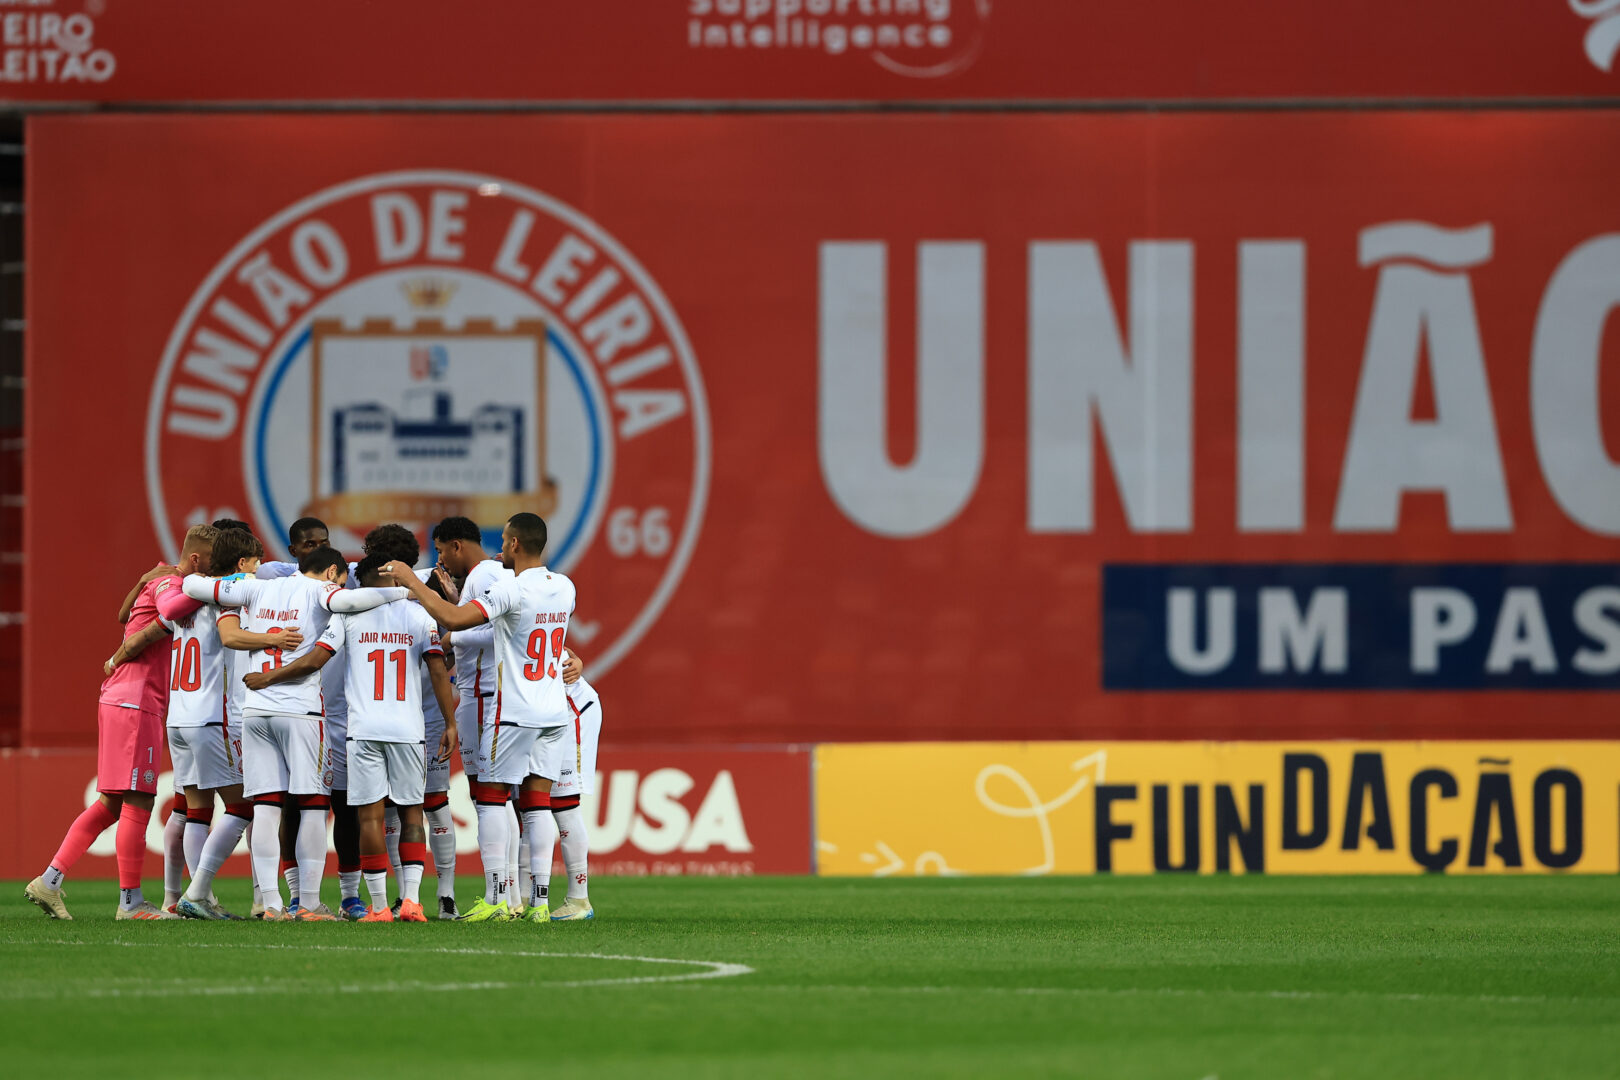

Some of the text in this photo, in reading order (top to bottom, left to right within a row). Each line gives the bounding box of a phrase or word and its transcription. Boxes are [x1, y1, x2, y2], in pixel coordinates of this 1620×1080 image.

[688, 18, 951, 53] Intelligence
[167, 191, 686, 439] UNIÃO DE LEIRIA
[608, 507, 671, 558] 66
[255, 608, 276, 620] JUAN
[359, 632, 379, 644] JAIR
[535, 612, 567, 625] DOS ANJOS
[1166, 587, 1620, 675] UM PAS
[171, 637, 202, 692] 10
[368, 649, 407, 702] 11
[524, 627, 565, 681] 99
[147, 746, 153, 764] 1
[1094, 751, 1584, 873] FUNDAÇÃO
